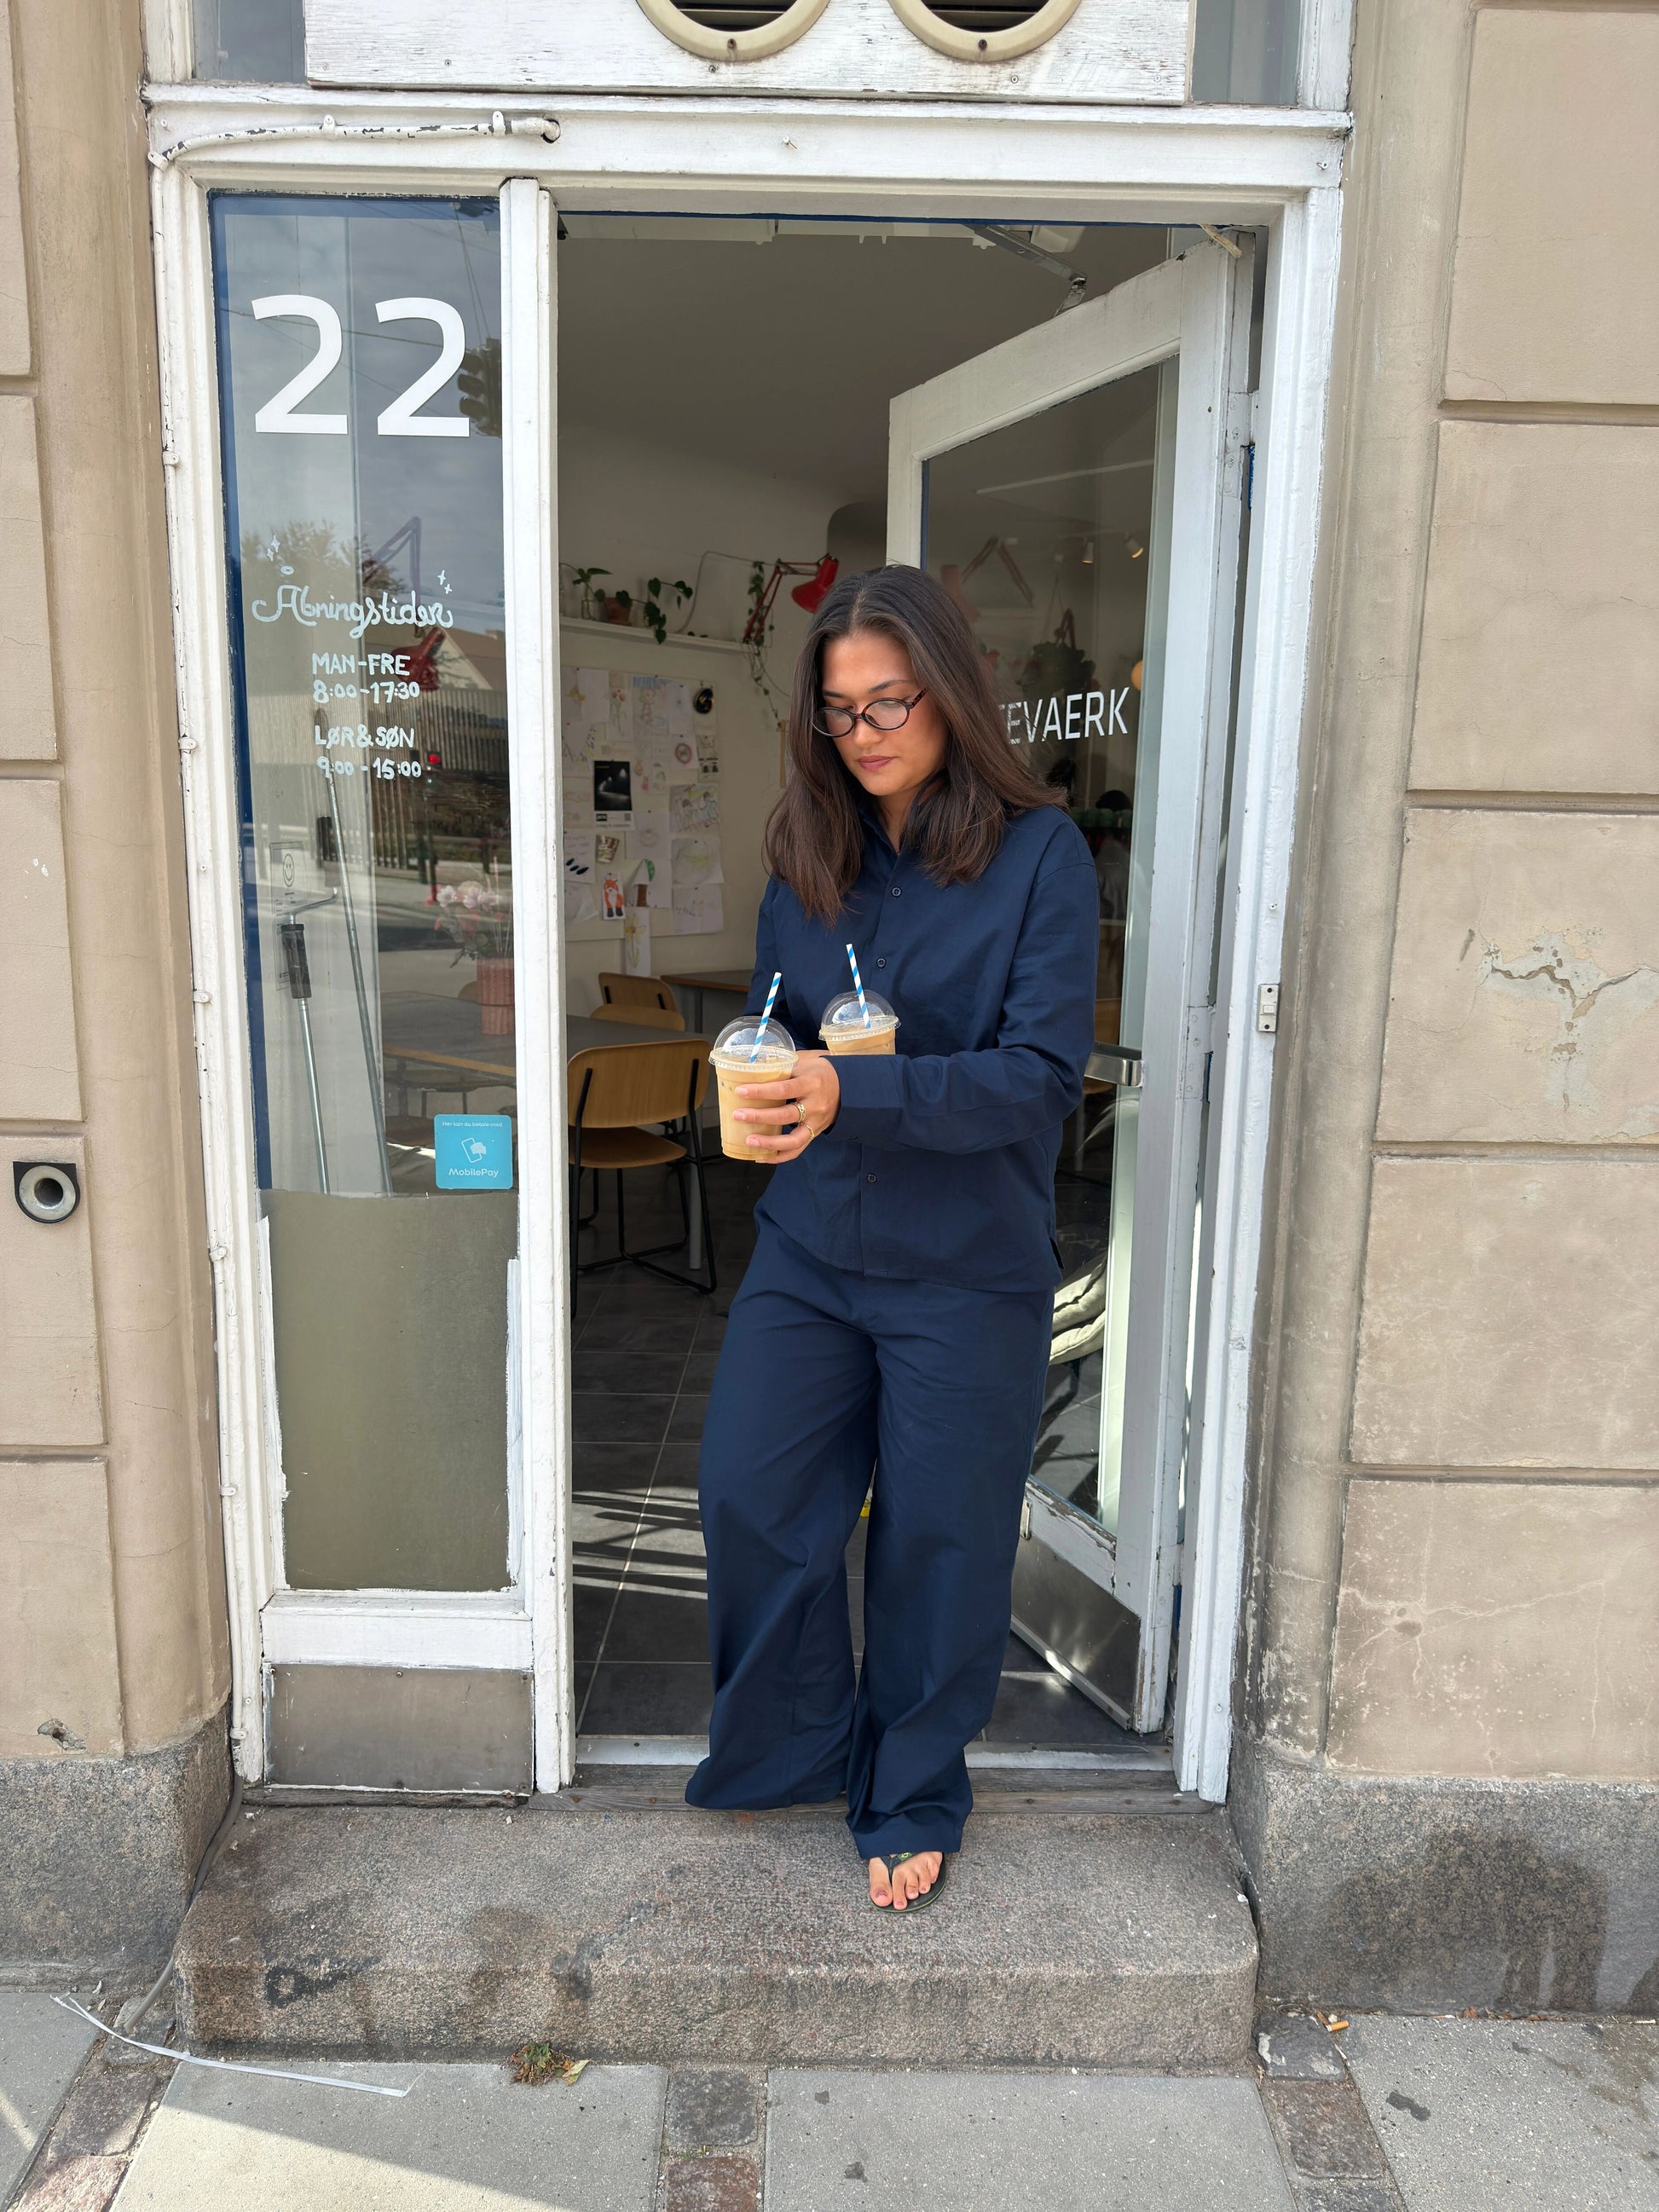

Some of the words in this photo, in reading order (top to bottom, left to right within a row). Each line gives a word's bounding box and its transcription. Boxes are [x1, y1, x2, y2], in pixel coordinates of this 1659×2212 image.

[251, 294, 470, 437] 22
[312, 652, 410, 676] MAN-FRE
[998, 686, 1130, 744] EVAERK
[448, 1168, 499, 1178] MobilePay
